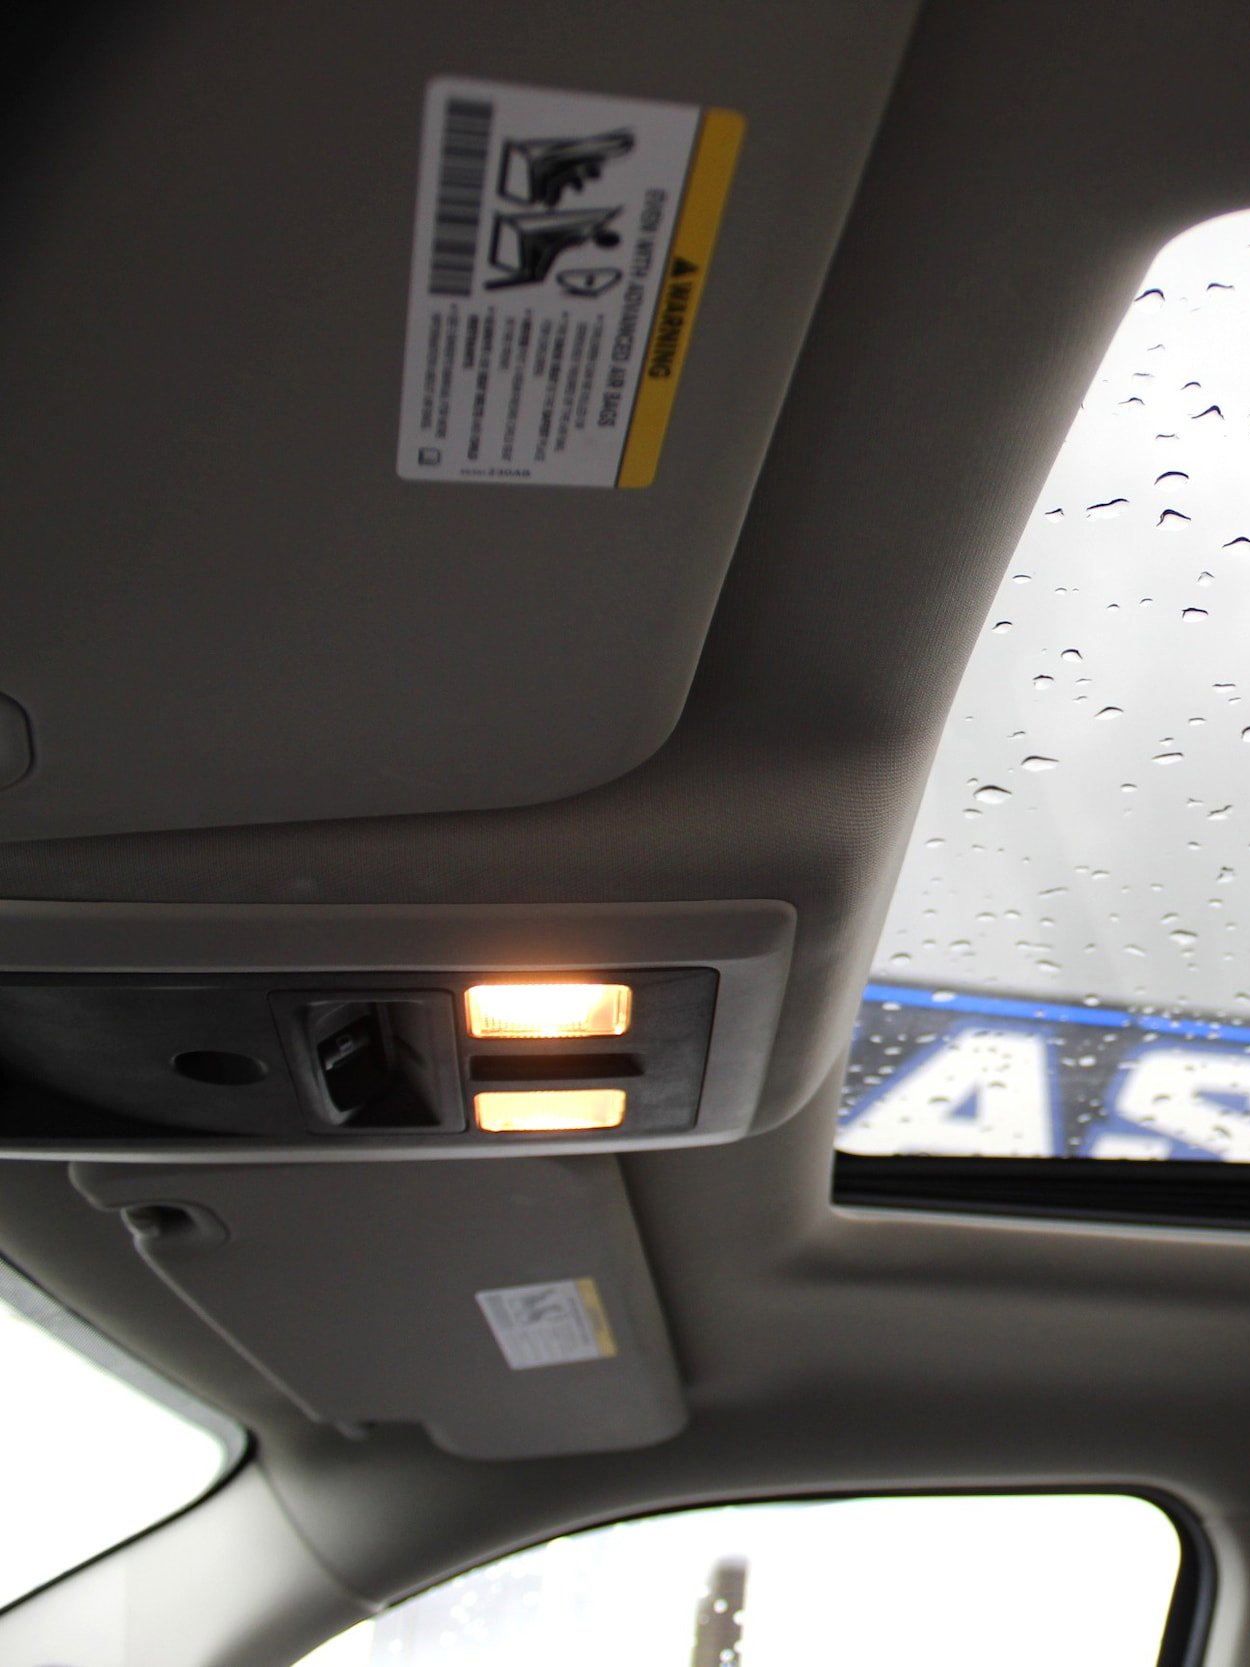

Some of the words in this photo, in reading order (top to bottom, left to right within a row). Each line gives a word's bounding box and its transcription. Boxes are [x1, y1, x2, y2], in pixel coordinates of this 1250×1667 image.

[630, 240, 653, 277] WITH
[611, 283, 644, 361] ADVANCED
[648, 282, 692, 378] WARNING
[608, 366, 626, 388] AIR
[598, 391, 621, 427] BAGS
